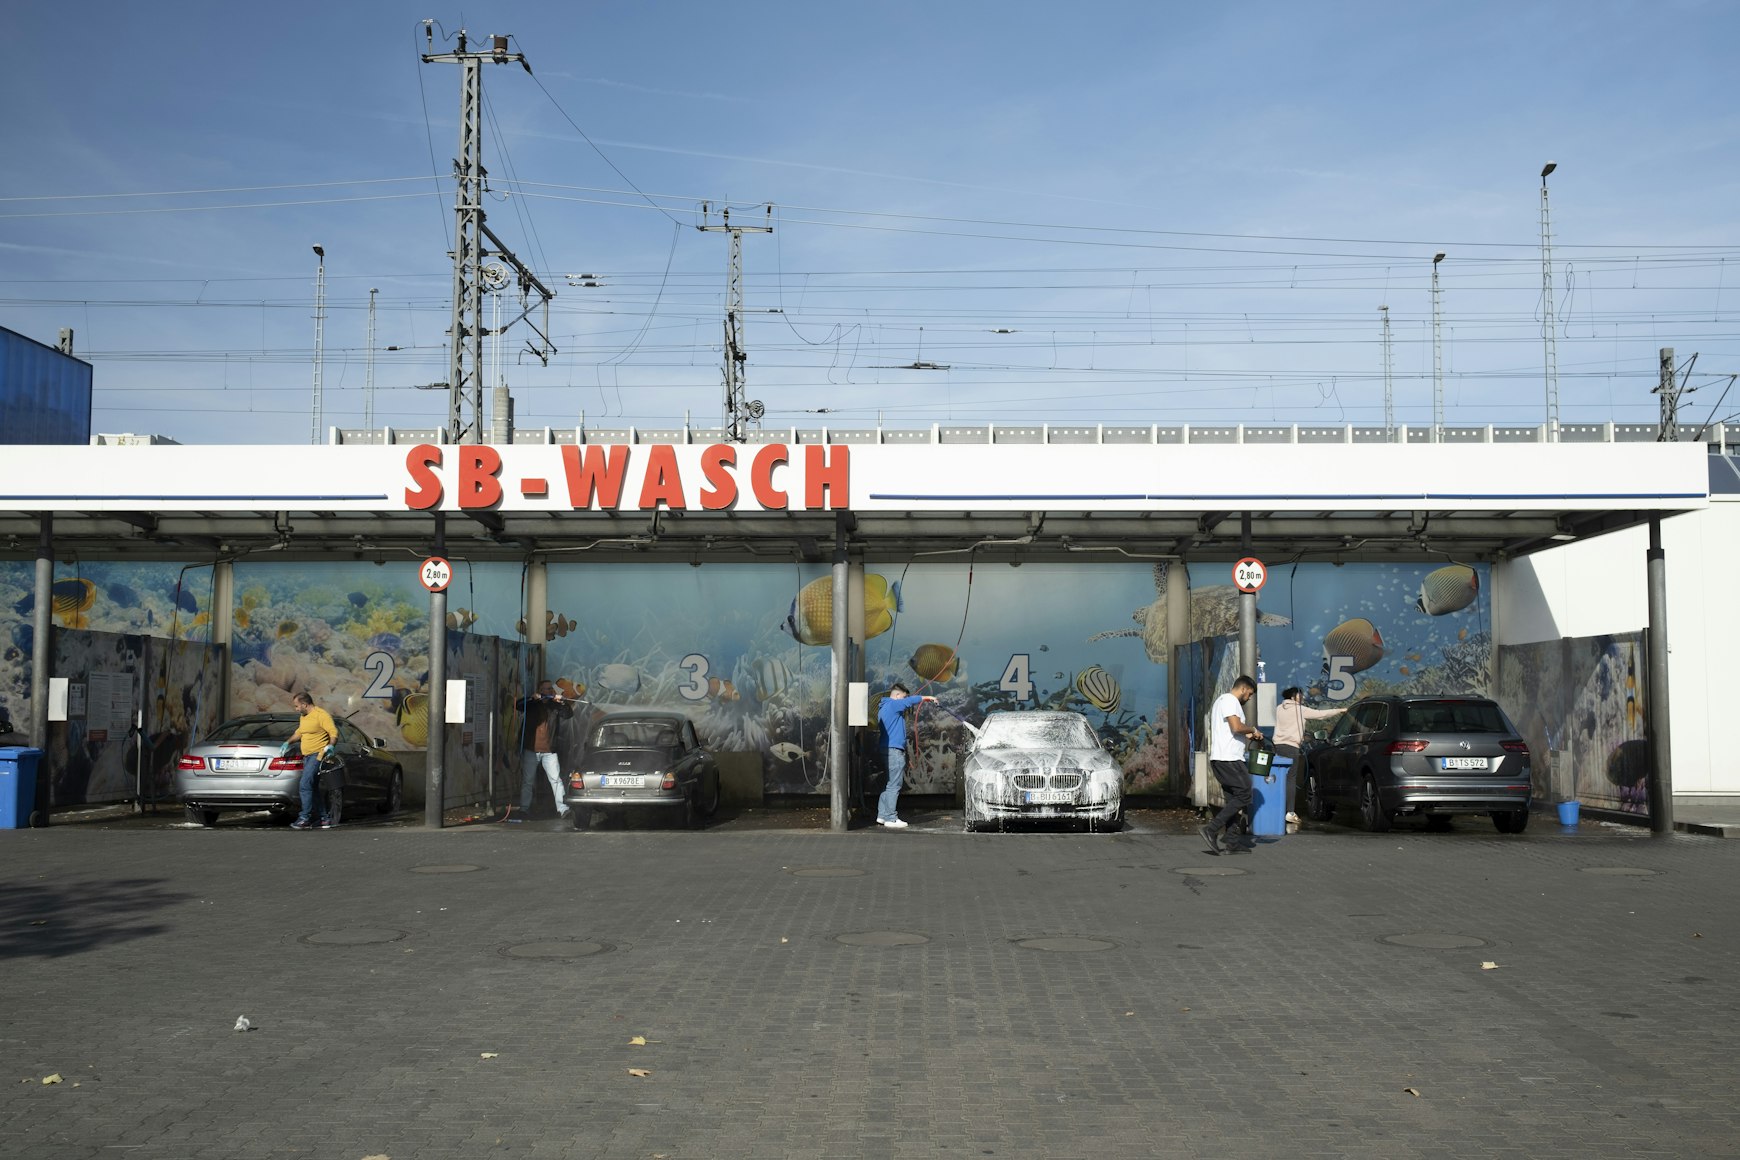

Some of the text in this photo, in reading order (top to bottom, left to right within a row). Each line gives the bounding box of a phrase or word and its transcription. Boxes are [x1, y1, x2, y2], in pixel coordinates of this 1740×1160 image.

[426, 568, 441, 580] 2,80
[1239, 569, 1255, 581] 2,80
[362, 651, 395, 698] 2
[678, 653, 710, 701] 3
[999, 653, 1034, 701] 4
[1326, 655, 1356, 702] 5
